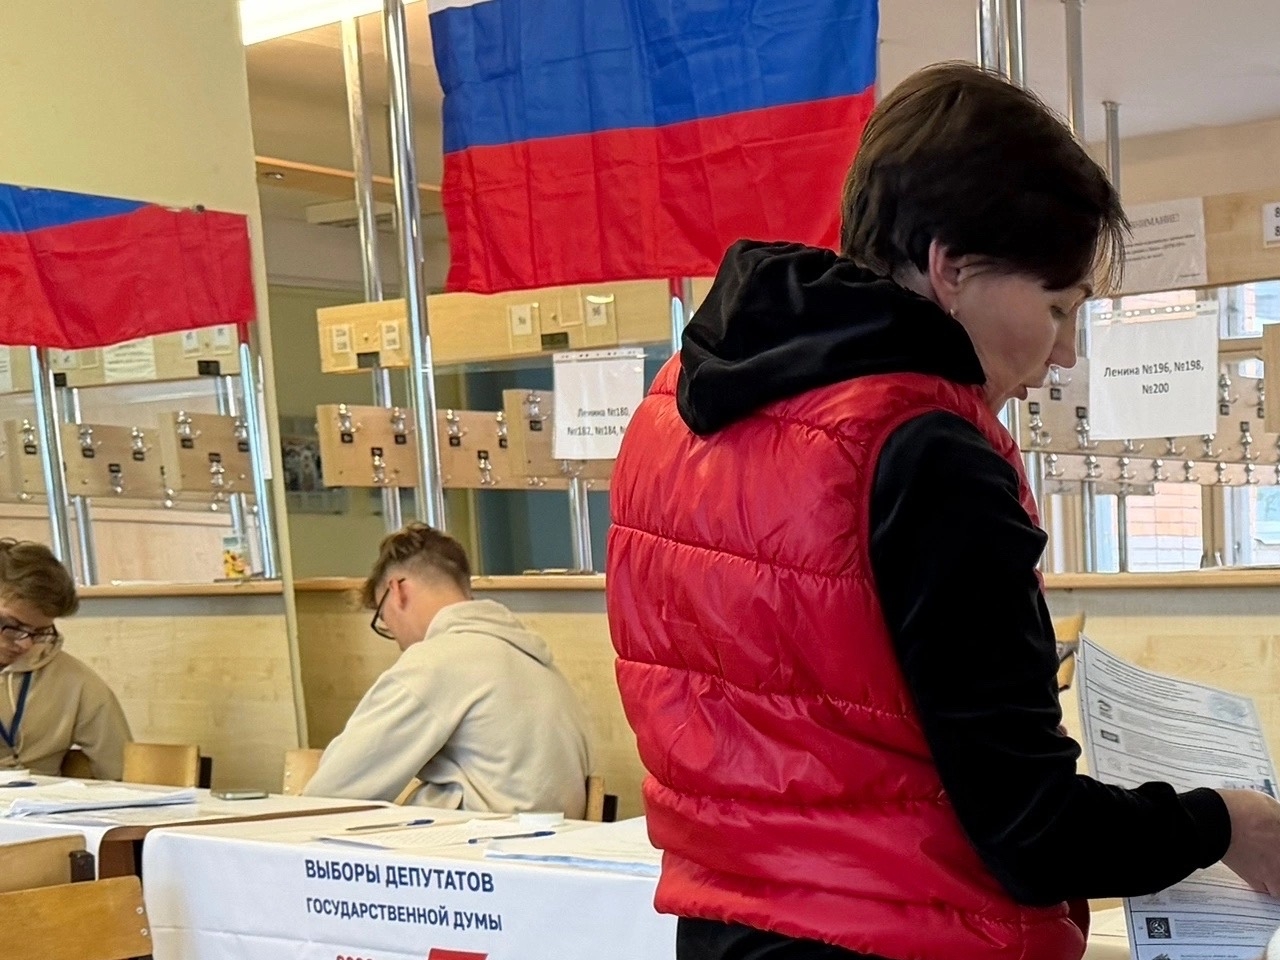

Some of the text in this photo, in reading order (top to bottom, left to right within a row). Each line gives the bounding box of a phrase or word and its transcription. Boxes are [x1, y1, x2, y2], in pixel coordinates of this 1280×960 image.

[1104, 359, 1204, 377] Ленина №196, №198,
[1142, 382, 1169, 394] №200
[305, 859, 495, 893] ВЫБОРЫ ДЕПУТАТОВ
[306, 897, 502, 931] ГОСУДАРСТВЕННОЙ ДУМЫ
